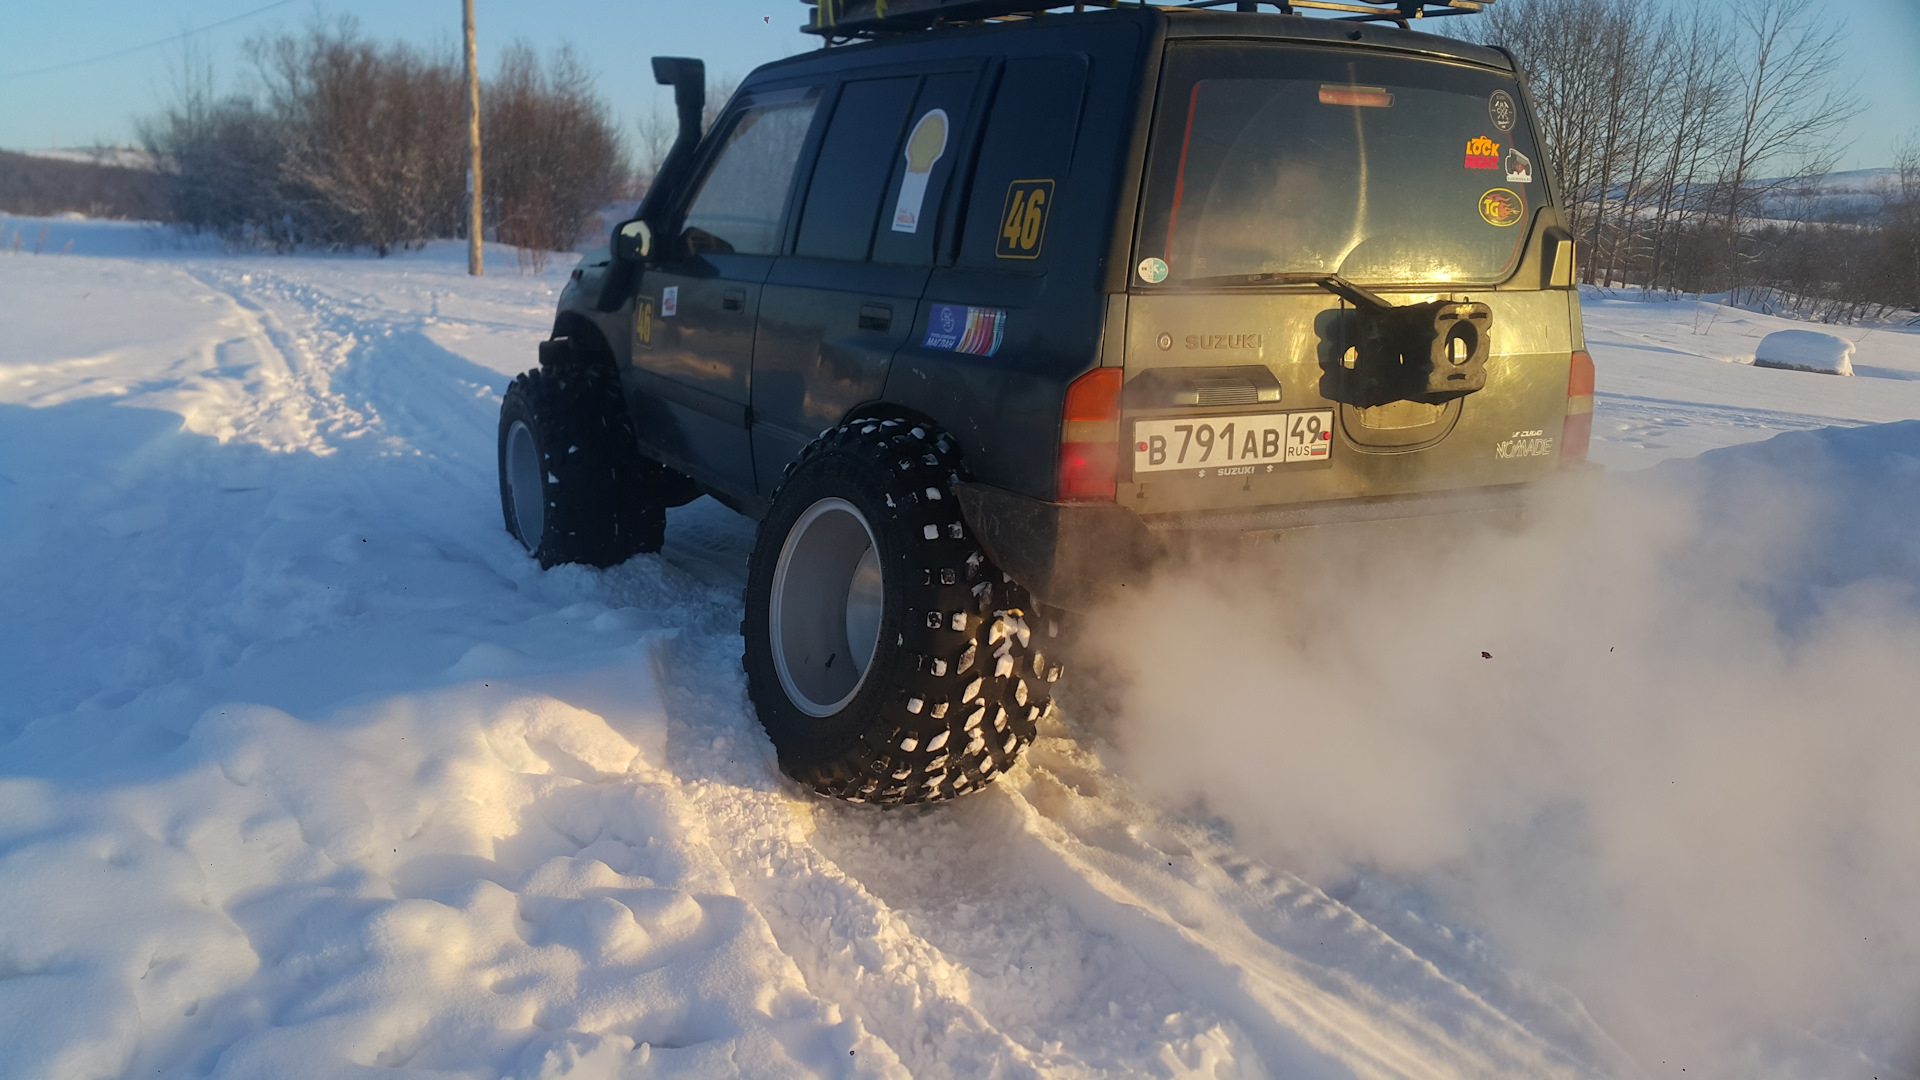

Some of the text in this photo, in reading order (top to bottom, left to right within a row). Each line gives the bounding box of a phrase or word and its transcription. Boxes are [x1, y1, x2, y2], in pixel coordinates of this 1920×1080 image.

[1466, 138, 1500, 156] LOCK
[1464, 156, 1499, 170] RIGHT
[1484, 200, 1500, 217] TG
[1003, 189, 1045, 249] 46
[638, 302, 651, 342] 46
[925, 337, 954, 348] МАГЛАН
[1185, 334, 1262, 349] SUZUKI
[1291, 415, 1321, 445] 49
[1288, 446, 1310, 456] RUS
[1217, 466, 1255, 476] SUZUKI
